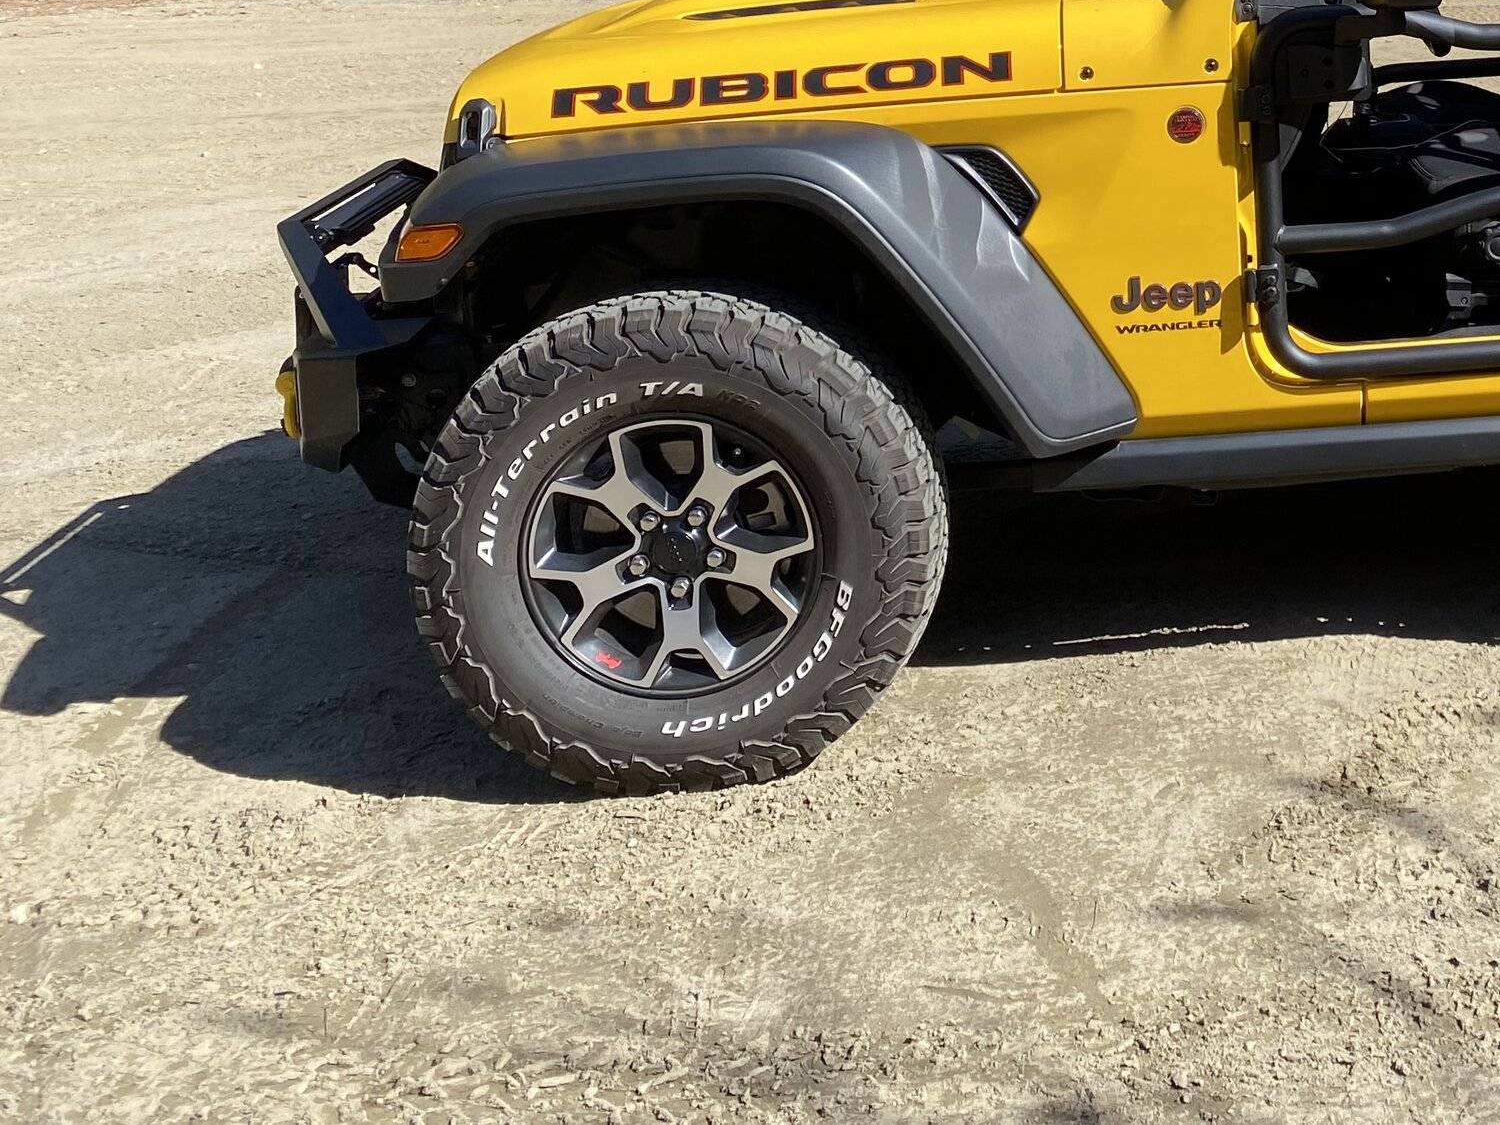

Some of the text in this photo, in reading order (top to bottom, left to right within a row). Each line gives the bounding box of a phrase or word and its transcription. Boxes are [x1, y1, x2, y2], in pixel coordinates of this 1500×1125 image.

[551, 50, 1013, 118] RUBICON
[1110, 275, 1222, 315] Jeep
[1115, 319, 1223, 334] WRANGLER
[477, 391, 617, 567] All-Terrain
[639, 381, 703, 397] T/A
[661, 579, 854, 738] BFGoodrich
